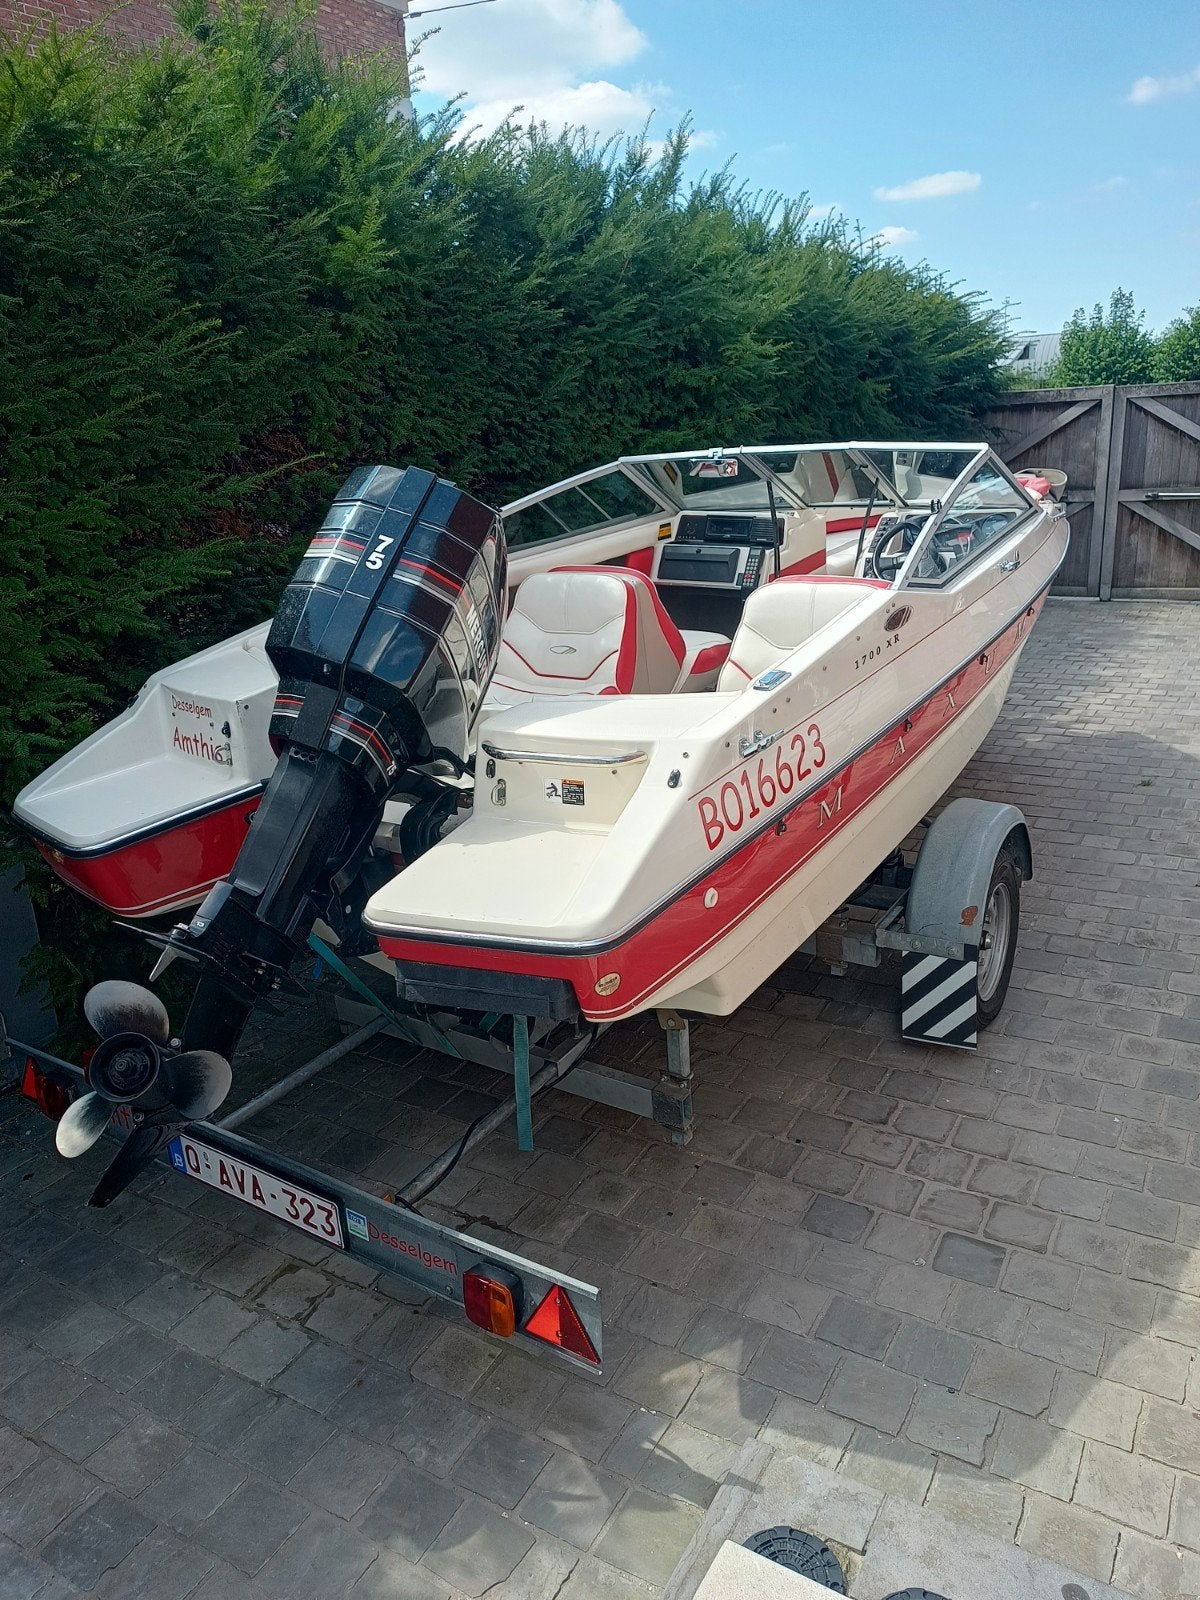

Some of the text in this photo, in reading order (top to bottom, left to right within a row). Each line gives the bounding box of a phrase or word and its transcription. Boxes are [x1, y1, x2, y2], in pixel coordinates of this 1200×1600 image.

[365, 534, 394, 570] 75
[854, 633, 900, 670] 1700 XR
[171, 694, 212, 719] Desselgem
[175, 1153, 184, 1167] B
[184, 1144, 336, 1237] Q-AVA-323
[368, 1222, 458, 1276] Desselgem
